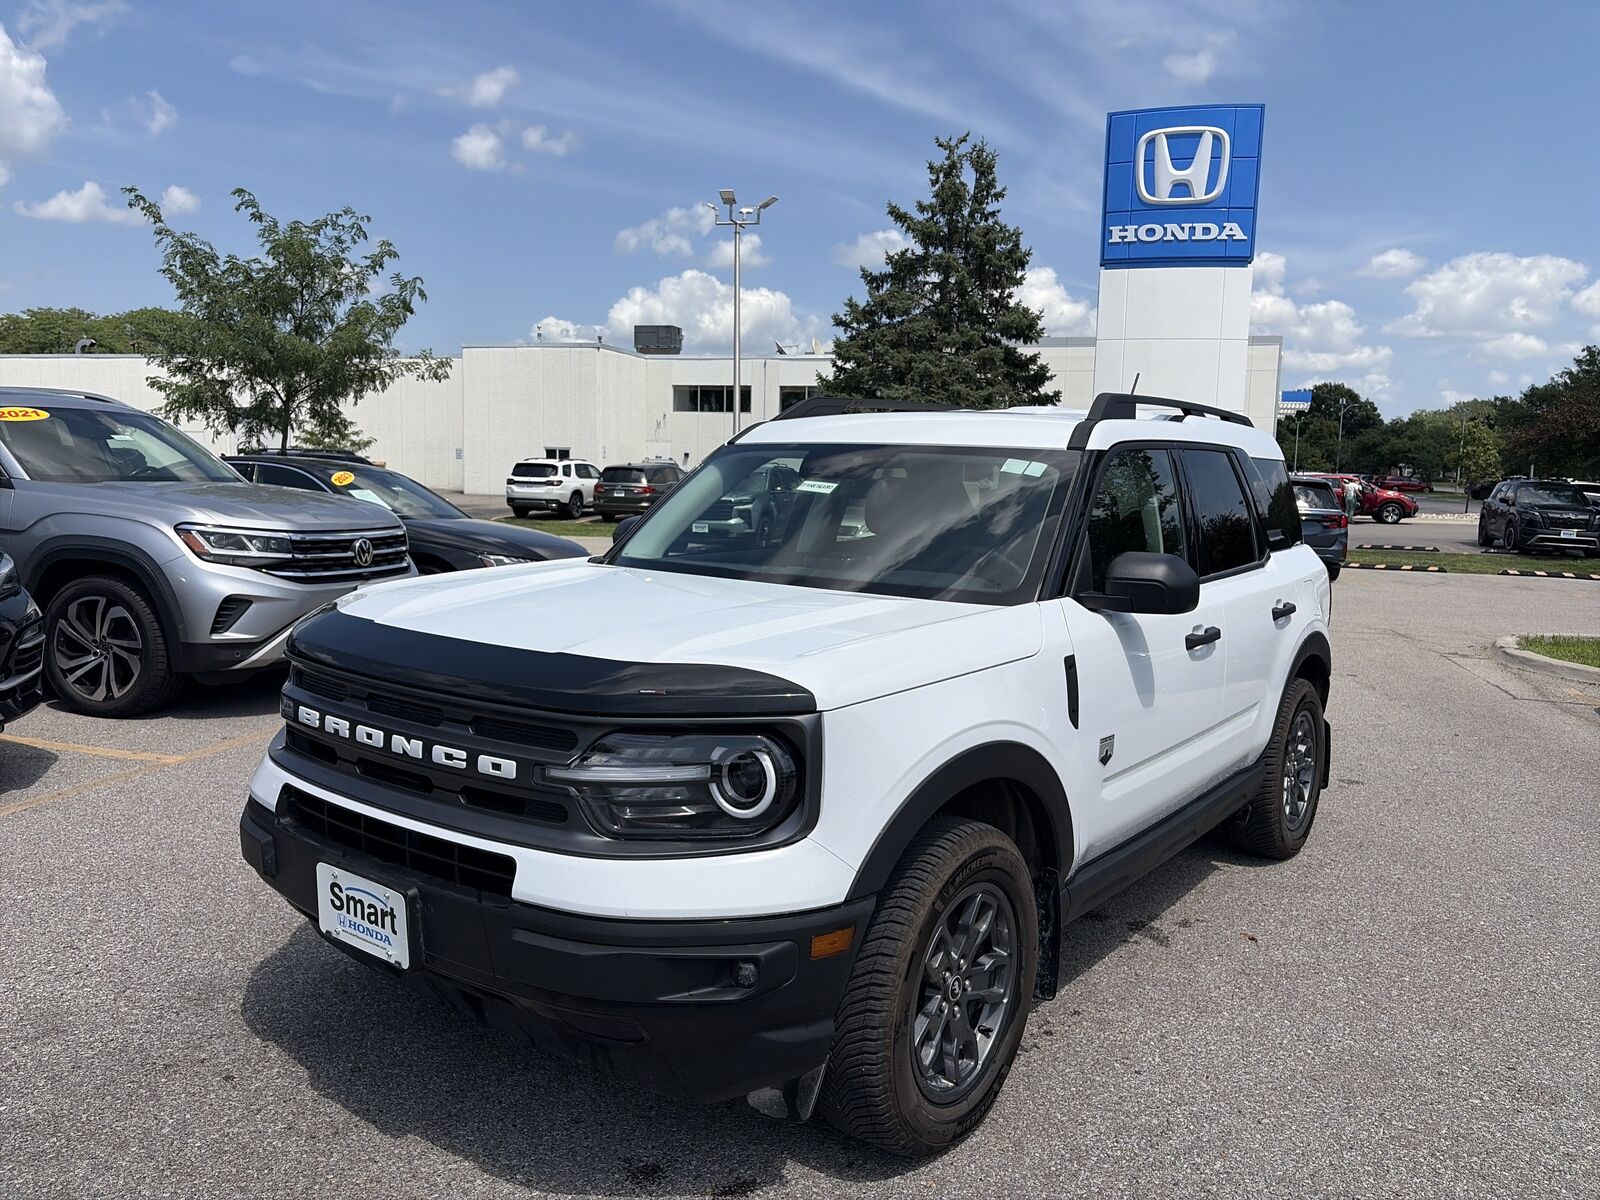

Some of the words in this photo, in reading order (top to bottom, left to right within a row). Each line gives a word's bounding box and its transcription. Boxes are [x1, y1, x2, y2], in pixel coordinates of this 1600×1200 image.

[1109, 223, 1247, 243] HONDA
[0, 410, 41, 418] 2021
[298, 706, 517, 780] BRONCO
[329, 882, 397, 935] Smart
[348, 919, 392, 946] HONDA
